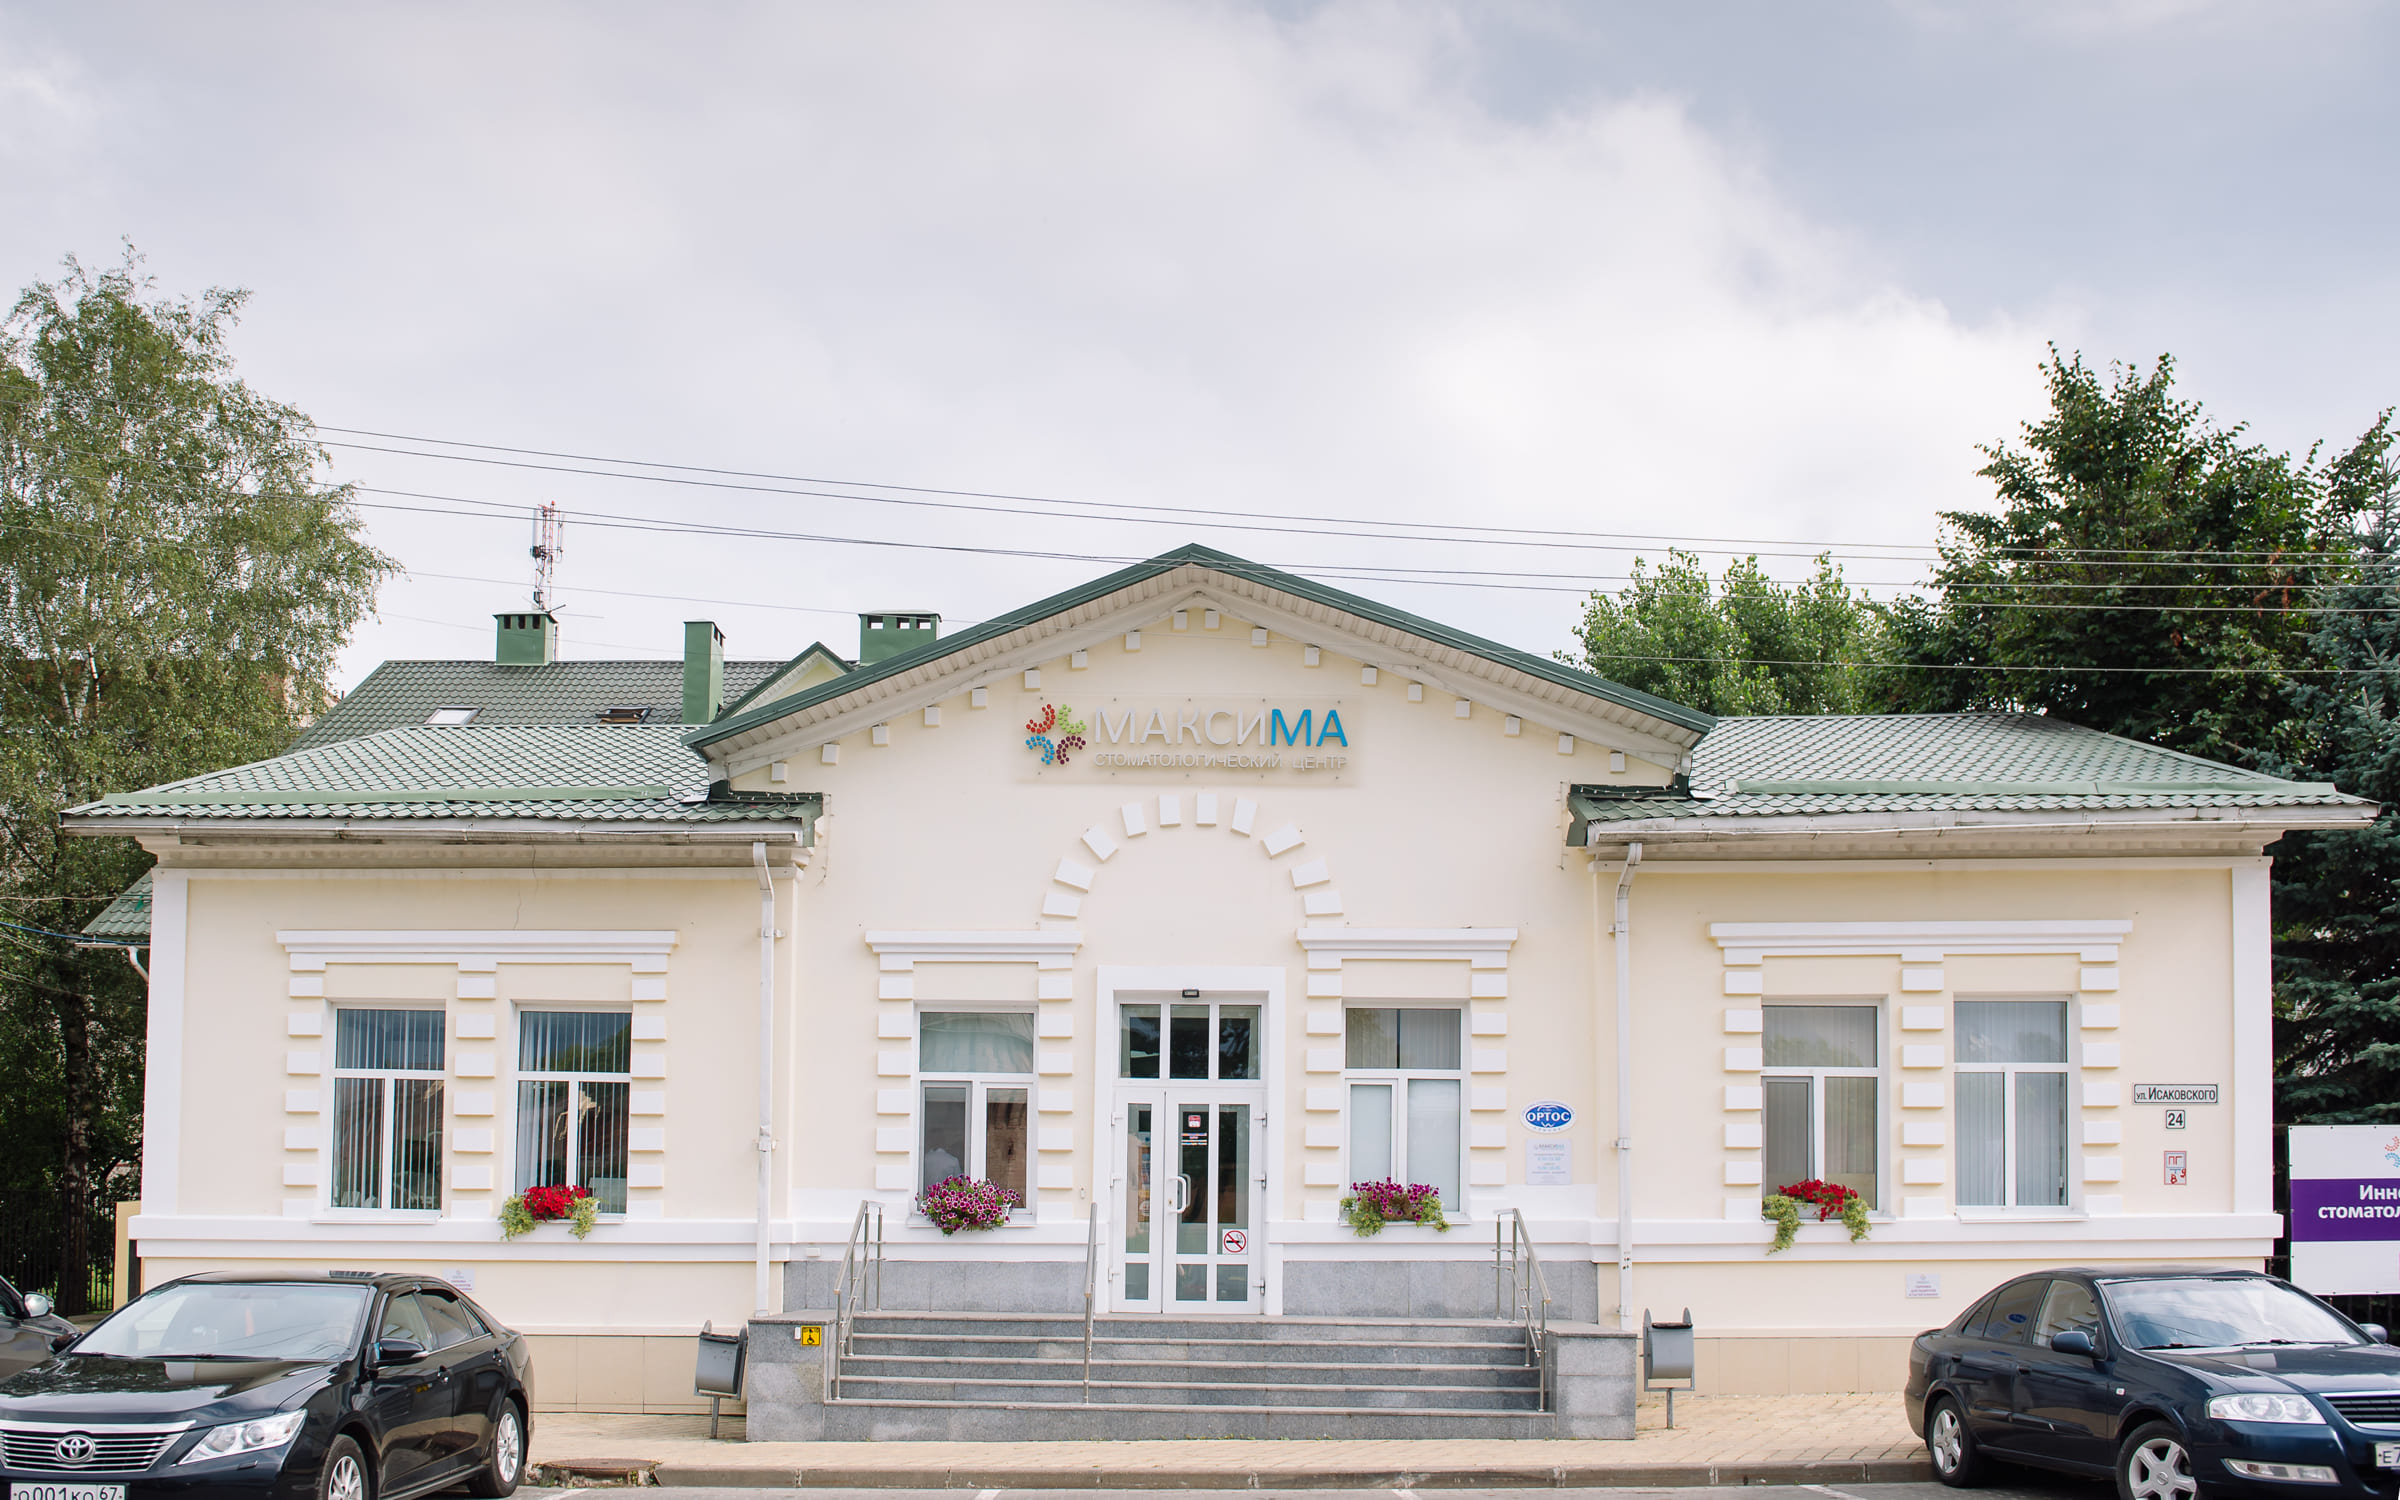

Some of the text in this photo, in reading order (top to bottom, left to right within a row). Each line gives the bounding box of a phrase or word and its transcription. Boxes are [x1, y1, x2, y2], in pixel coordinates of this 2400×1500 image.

[1094, 706, 1348, 747] МАКСИМА
[1094, 752, 1349, 771] СТОМАТОЛОГИЧЕСКИЙ ЦЕНТР
[1527, 1112, 1570, 1121] ОРТОС
[2167, 1112, 2184, 1127] 24
[2168, 1155, 2183, 1166] ПГ
[2359, 1184, 2400, 1201] Инн
